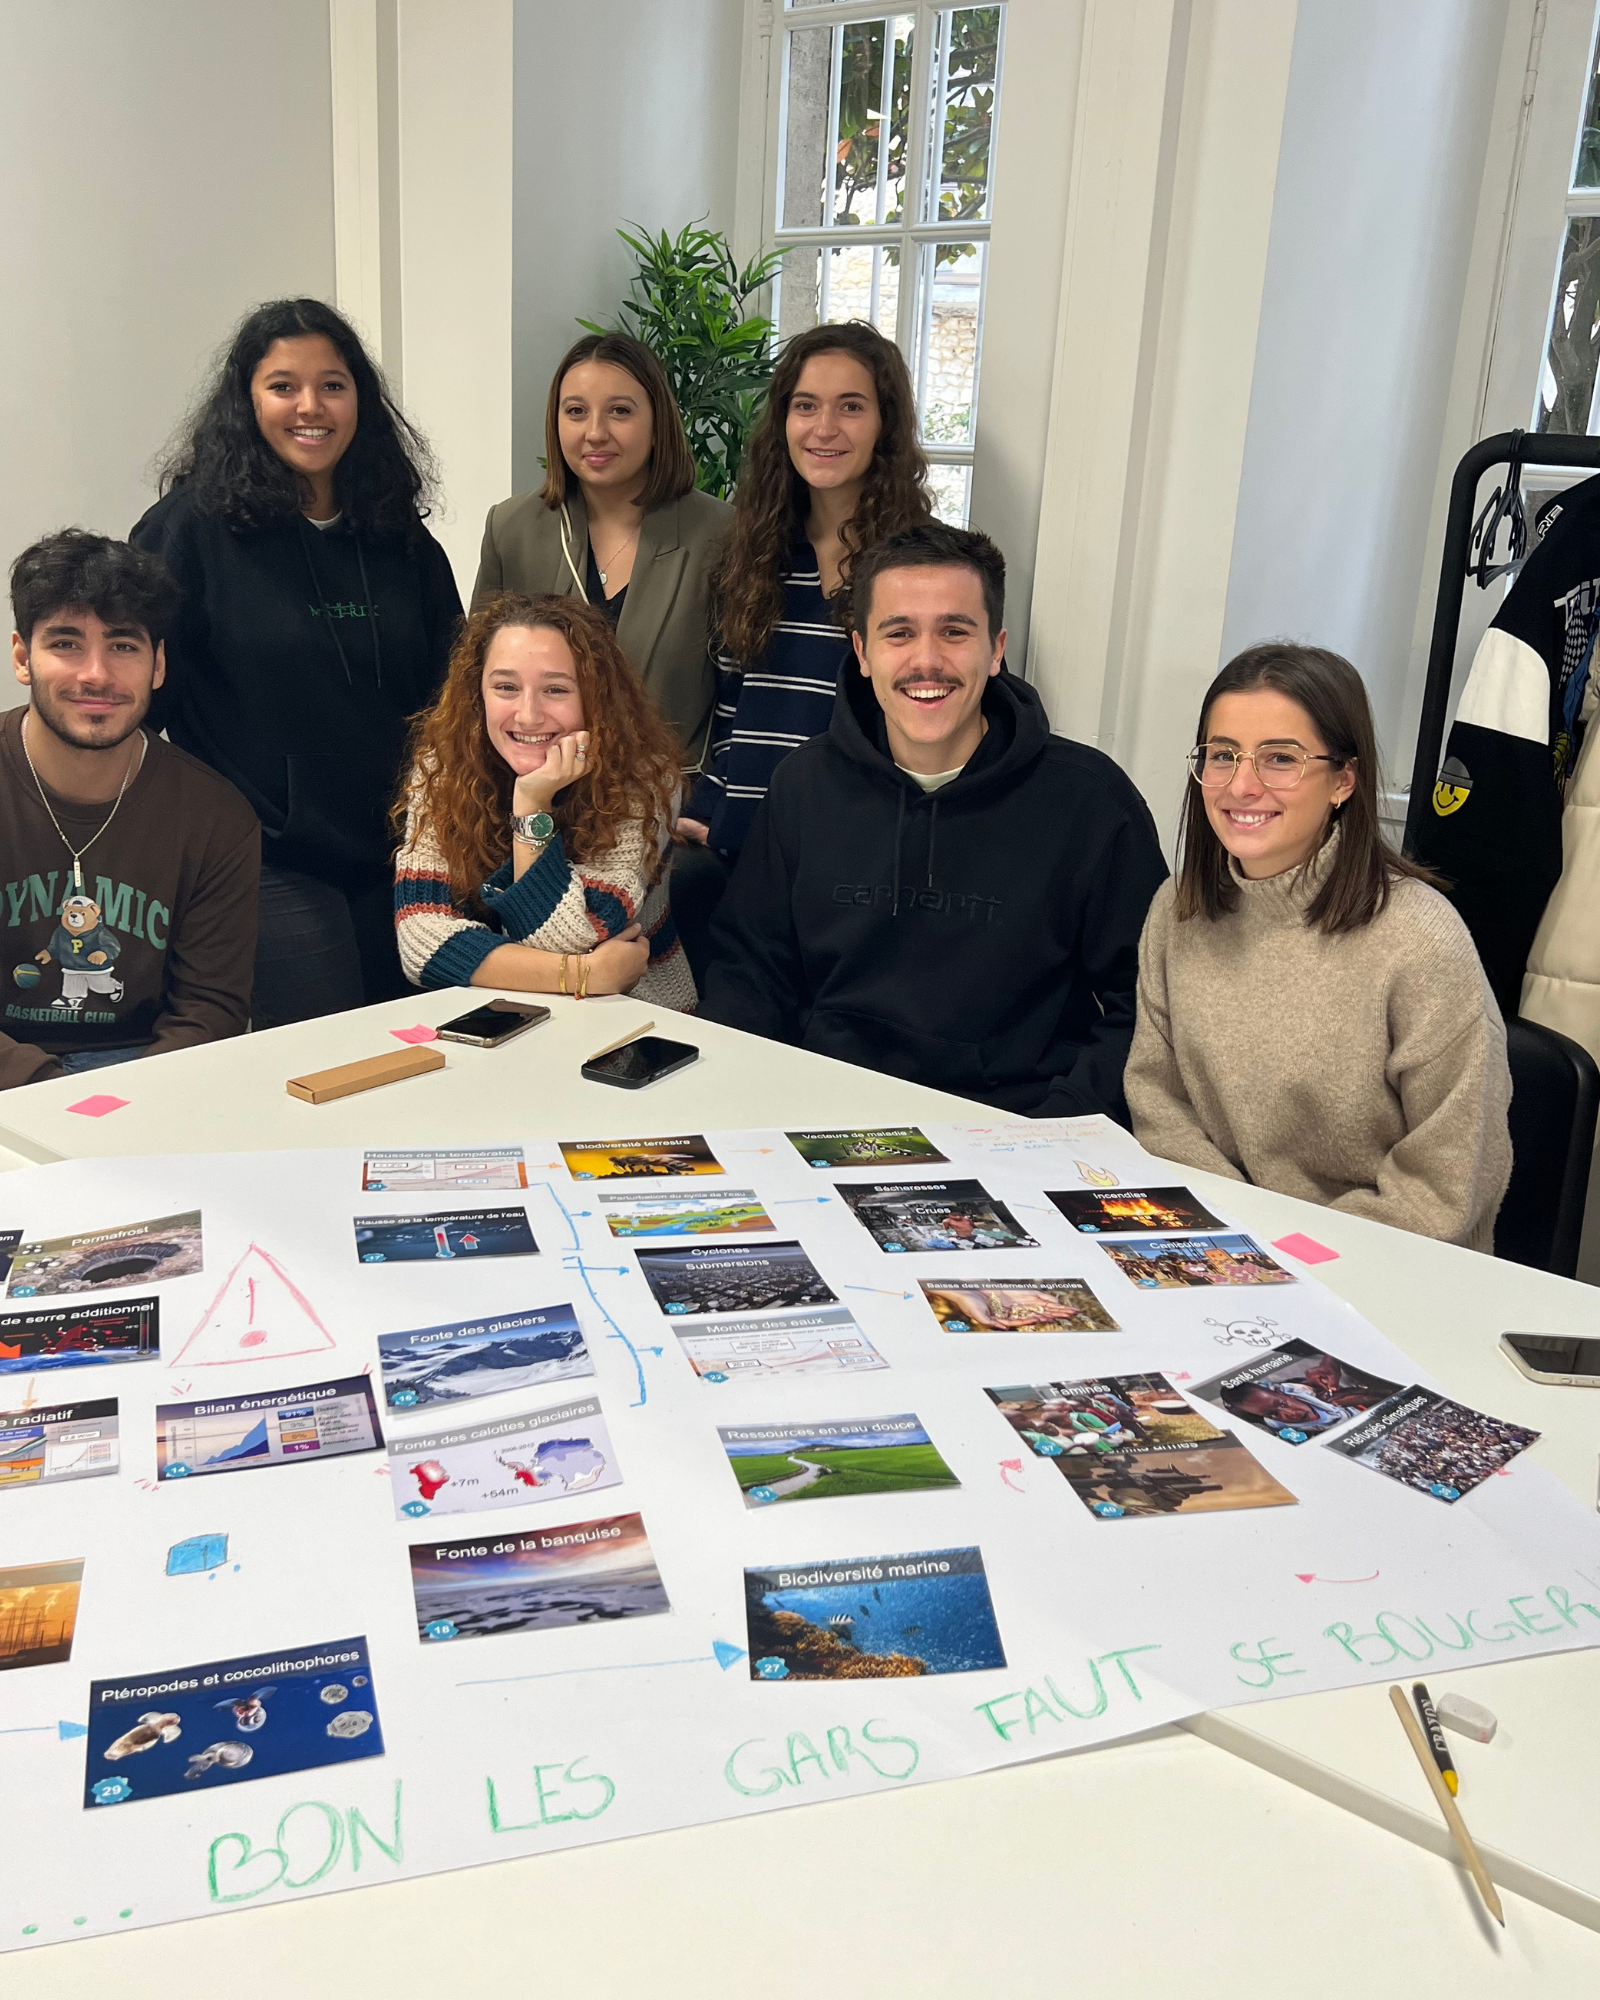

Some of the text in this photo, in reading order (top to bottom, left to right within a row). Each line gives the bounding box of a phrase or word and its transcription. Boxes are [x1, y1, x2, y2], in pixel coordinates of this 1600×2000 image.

[0, 869, 170, 950] YNAMIC
[71, 939, 84, 954] P
[5, 1003, 116, 1024] BASKETBALL CLUB
[867, 1130, 908, 1138] maladie
[576, 1139, 691, 1150] Biodiversité terrestre
[449, 1150, 521, 1158] température
[874, 1184, 947, 1192] Sécheresses
[609, 1193, 667, 1201] Perturbation
[684, 1192, 708, 1200] cycle
[1093, 1191, 1148, 1200] Incendies
[425, 1213, 484, 1224] température
[501, 1211, 525, 1219] l'eau
[915, 1207, 952, 1215] Crues
[71, 1225, 149, 1247] Permafrost
[691, 1246, 751, 1257] Cyclones
[1149, 1240, 1209, 1250] Canicules
[685, 1258, 770, 1271] Submersions
[1040, 1282, 1083, 1291] agricoles
[1, 1302, 155, 1326] de serre additionnel
[409, 1314, 547, 1345] Fonte des glaciers
[705, 1316, 825, 1335] Montée des eaux
[709, 1373, 723, 1381] 22
[1220, 1353, 1294, 1390] Santé humaine
[1050, 1384, 1112, 1397] Famines
[194, 1387, 338, 1416] Bilan énergétique
[13, 1409, 74, 1426] radiatif
[1342, 1394, 1429, 1449] Réfugiés climatiques
[394, 1403, 595, 1453] Fonte des calottes glaciaires
[727, 1419, 916, 1440] Ressources en eau douce
[170, 1466, 187, 1475] 14
[450, 1477, 480, 1488] +7m
[481, 1487, 519, 1500] +54m
[756, 1489, 770, 1498] 31
[408, 1504, 424, 1514] 19
[1102, 1505, 1117, 1515] 40
[435, 1524, 622, 1561] Fonte de la banquise
[778, 1559, 951, 1588] Biodiversité marine
[433, 1625, 450, 1635] 18
[764, 1663, 780, 1674] 27
[101, 1649, 361, 1702] Ptéropodes et coccolithophores
[207, 1777, 402, 1903] BON
[485, 1755, 617, 1834] LES
[723, 1717, 920, 1797] GARS
[973, 1644, 1163, 1743] FAUT
[1229, 1636, 1307, 1689] SE
[102, 1784, 122, 1797] 29
